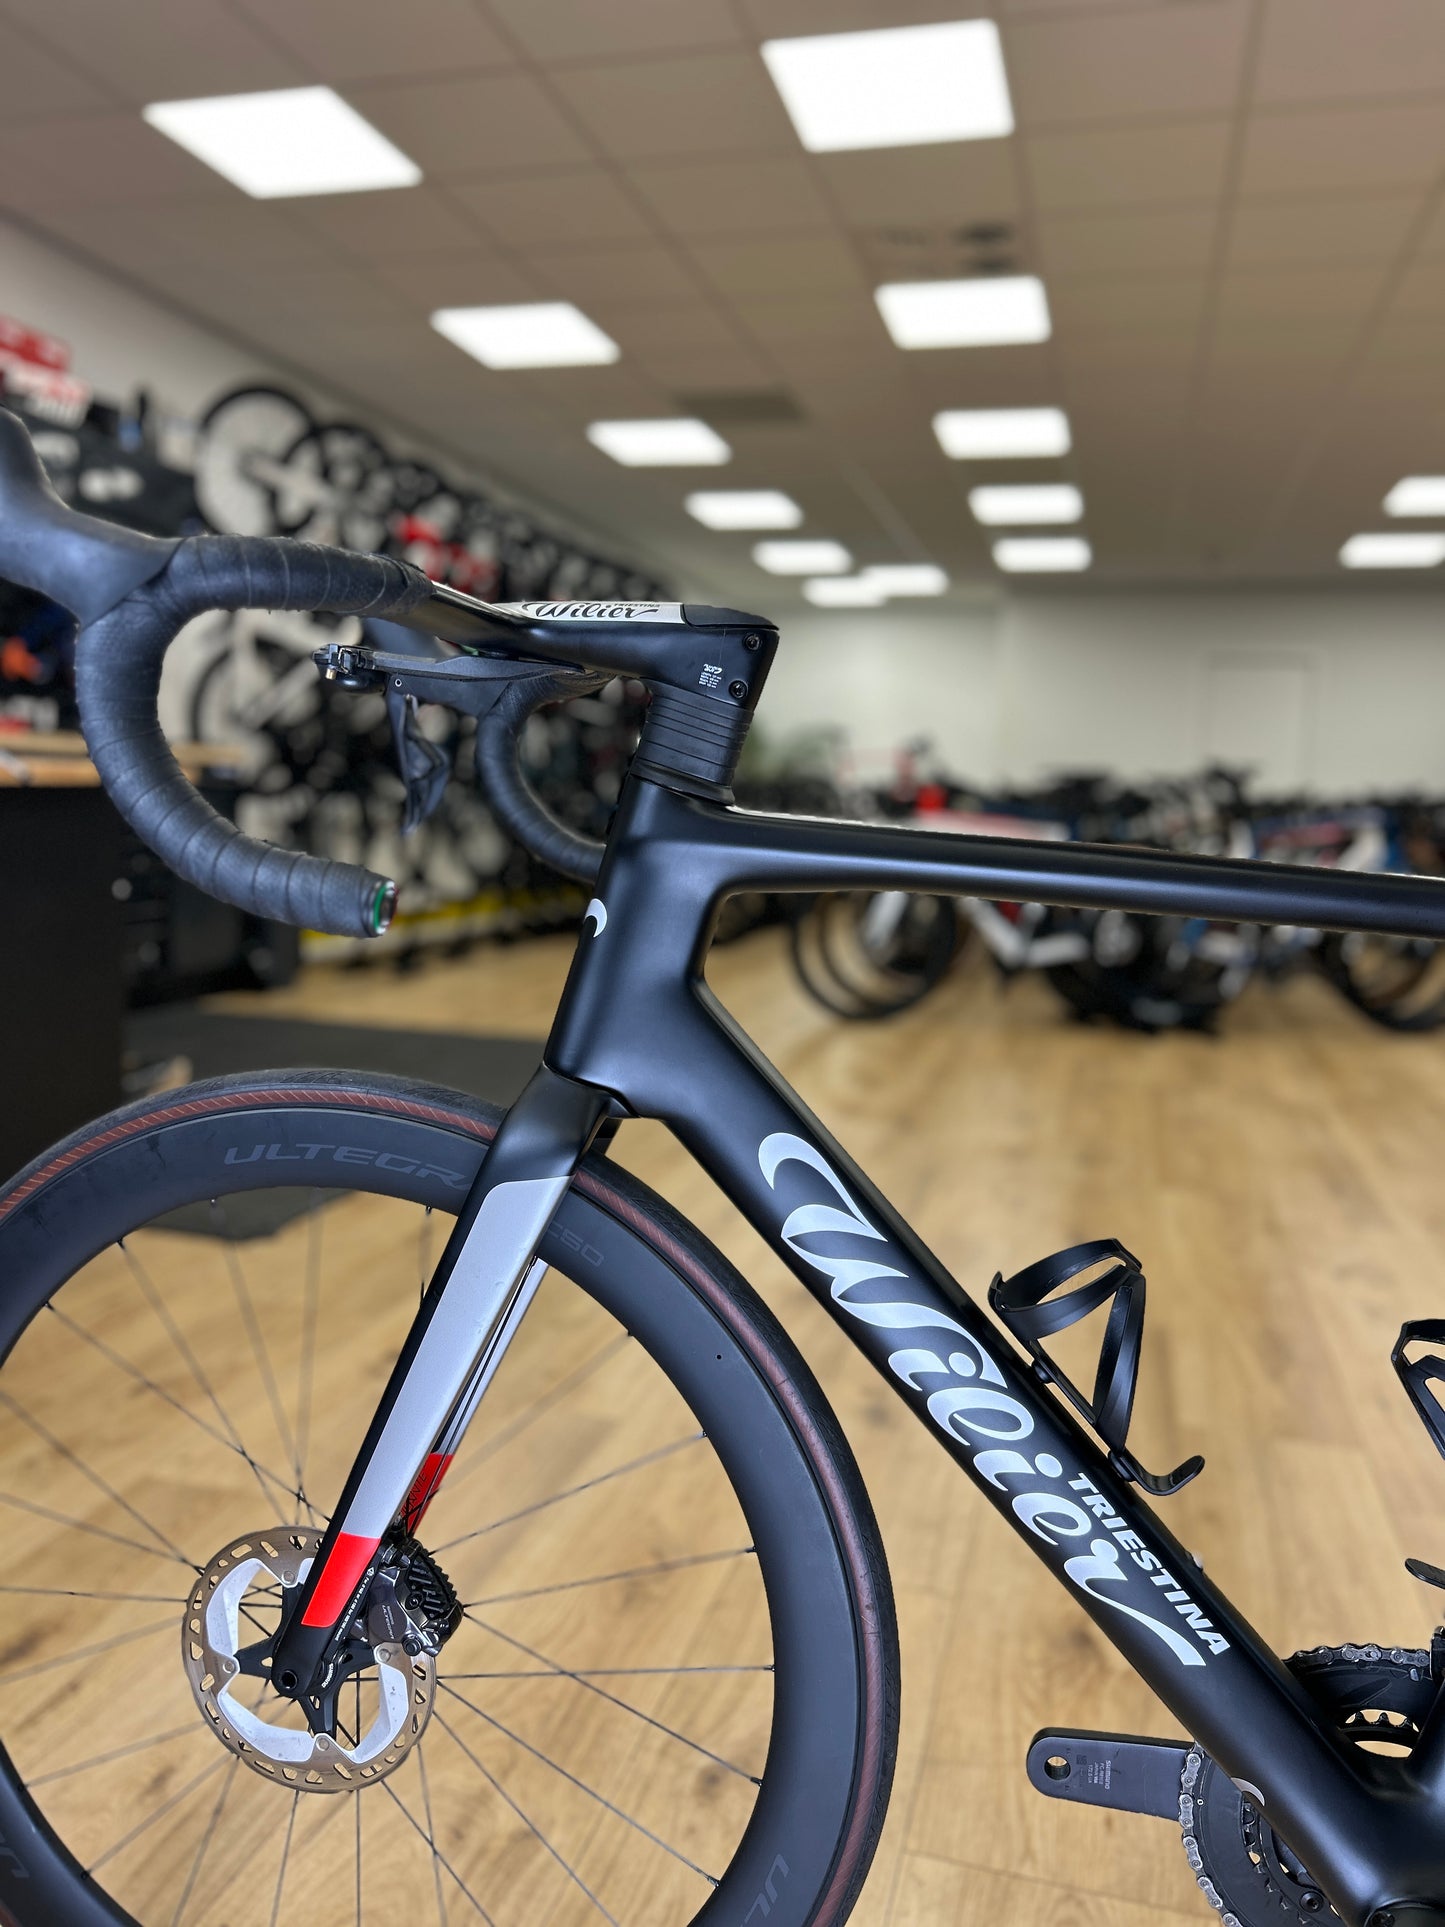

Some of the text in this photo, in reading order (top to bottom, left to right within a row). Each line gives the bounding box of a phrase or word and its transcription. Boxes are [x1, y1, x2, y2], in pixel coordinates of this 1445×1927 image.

[521, 602, 659, 619] Wilier
[224, 1143, 472, 1190] ULTEGR
[758, 1132, 1207, 1666] Wilier
[1068, 1472, 1231, 1656] TRIESTINA
